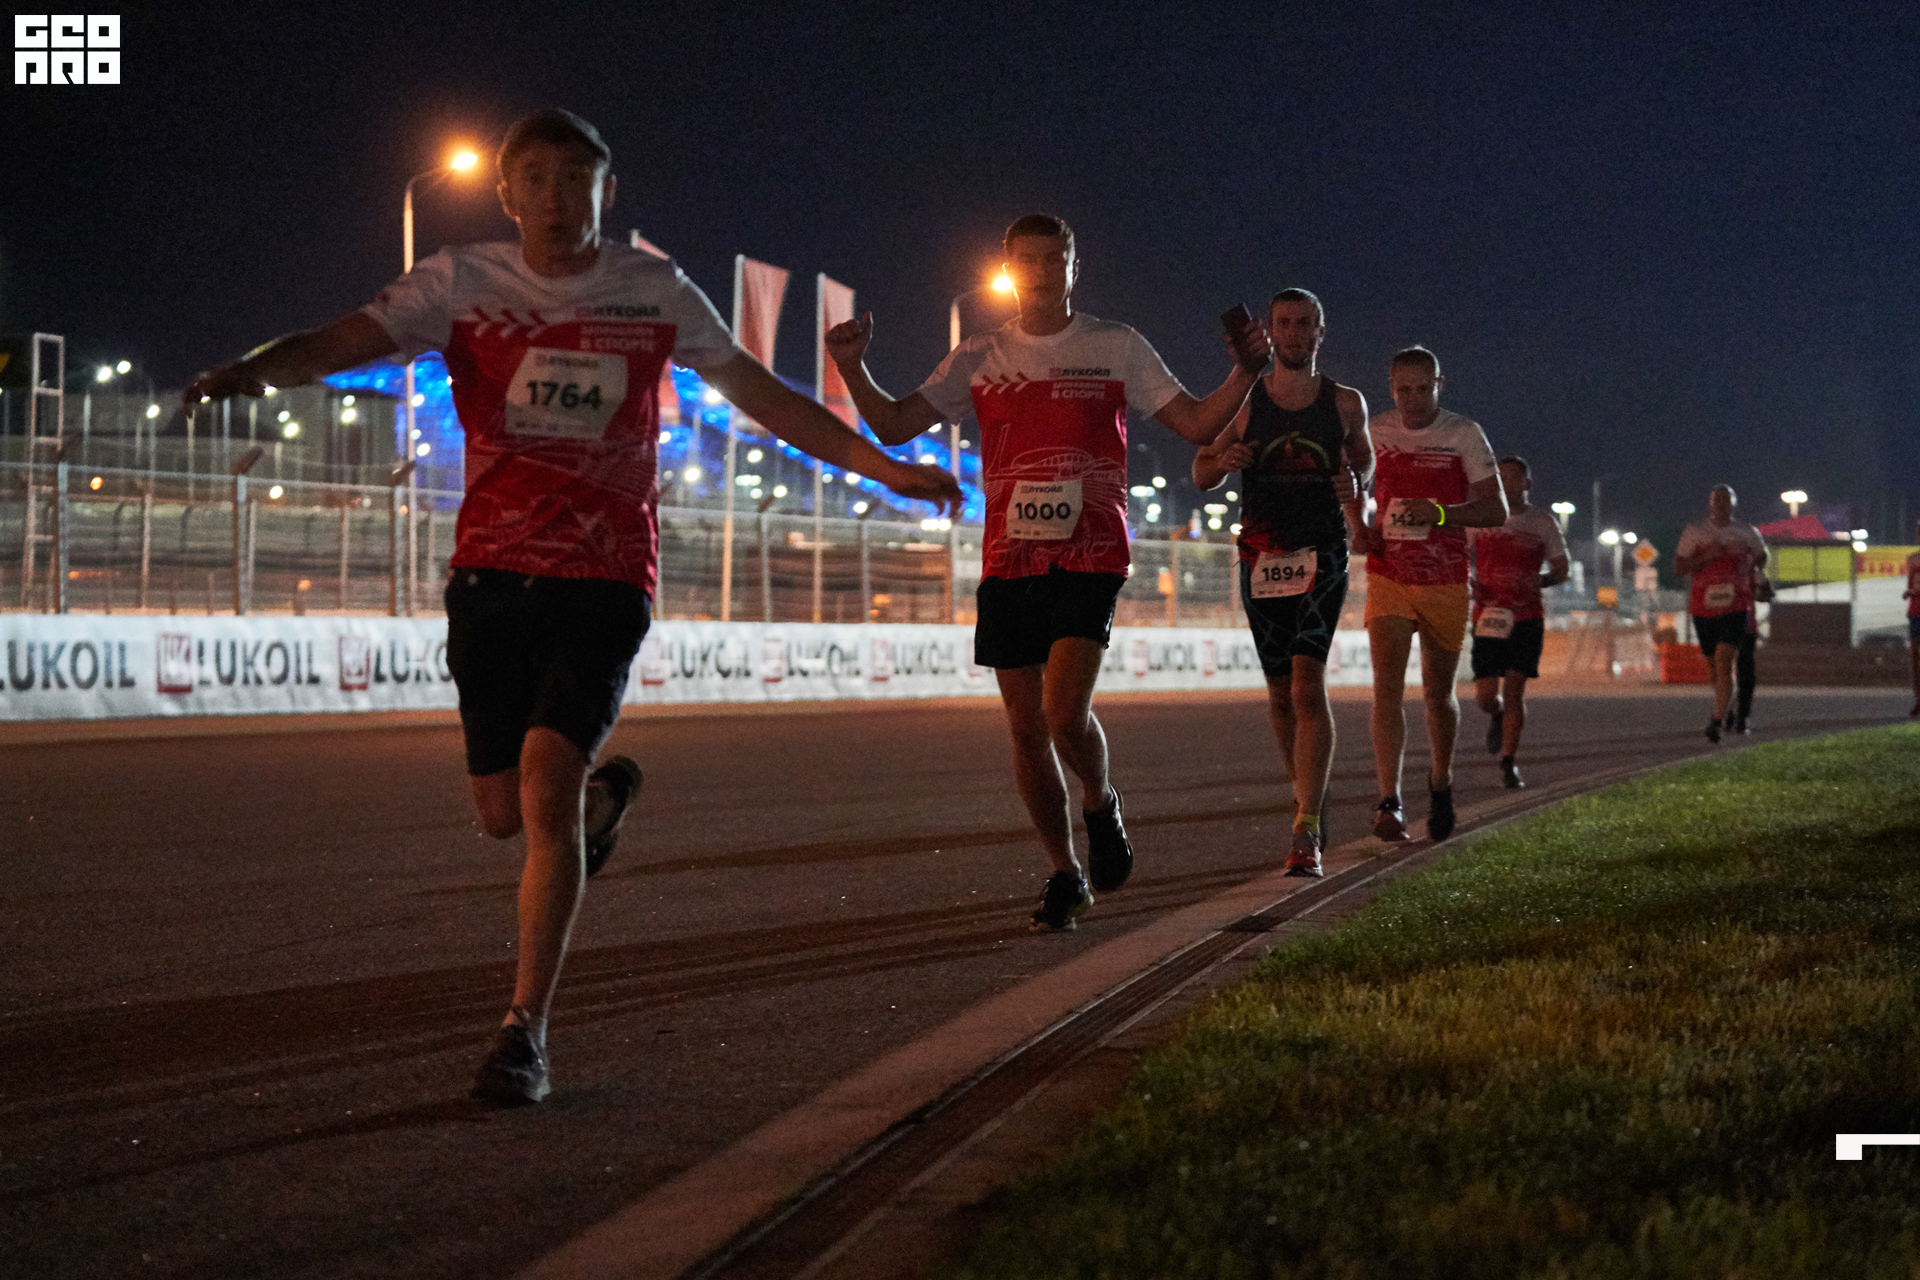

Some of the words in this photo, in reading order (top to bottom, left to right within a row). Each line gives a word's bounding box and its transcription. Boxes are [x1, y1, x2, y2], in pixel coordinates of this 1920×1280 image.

[1062, 366, 1111, 377] ЛУКОЙЛ
[527, 380, 602, 411] 1764
[1015, 502, 1071, 521] 1000
[1391, 513, 1425, 527] 142
[1262, 565, 1307, 581] 1894
[0, 638, 136, 691] UKOIL
[198, 638, 321, 687] LUKOIL
[373, 639, 453, 684] LUKO
